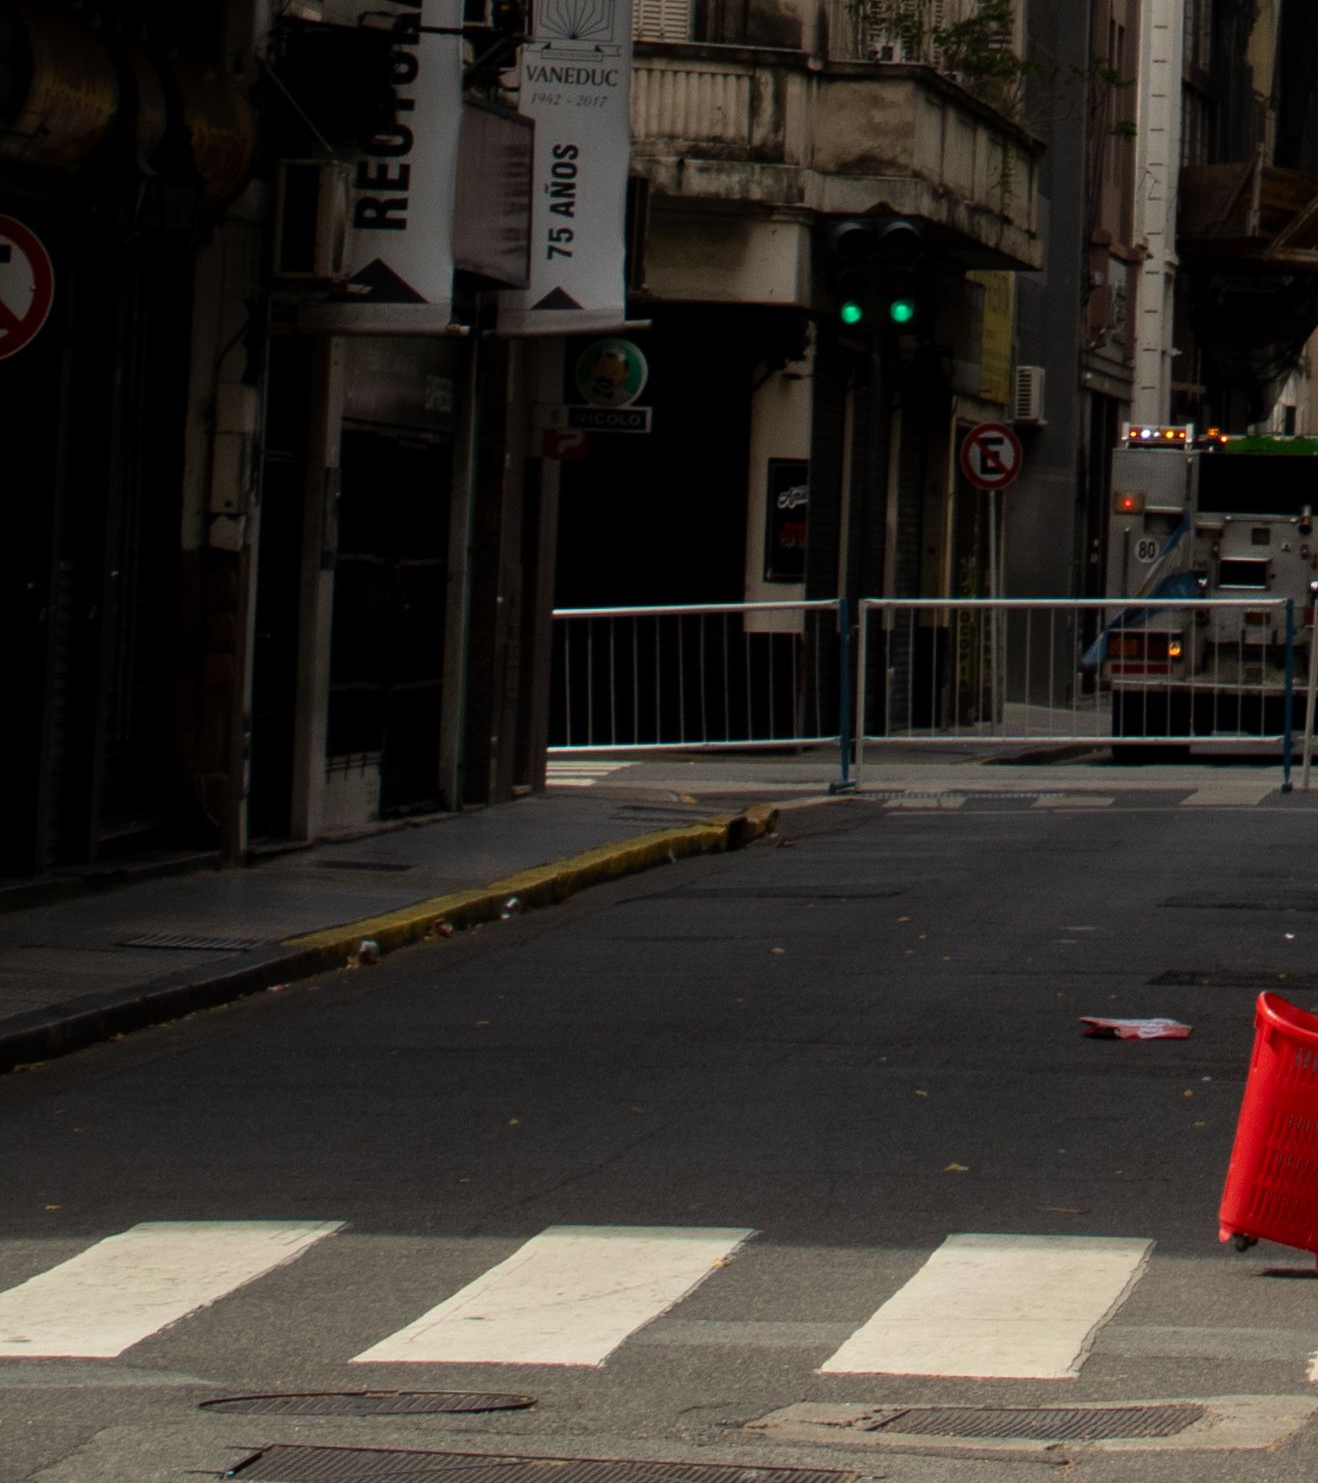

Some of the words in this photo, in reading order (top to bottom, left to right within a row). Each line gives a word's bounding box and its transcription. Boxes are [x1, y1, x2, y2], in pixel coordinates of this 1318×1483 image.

[526, 65, 619, 87] VANEDUC
[531, 92, 561, 105] 1942
[575, 95, 608, 108] 2017
[544, 143, 579, 218] AÑOS
[547, 228, 573, 260] 75
[574, 411, 641, 426] NICOLO
[1138, 541, 1156, 559] 80
